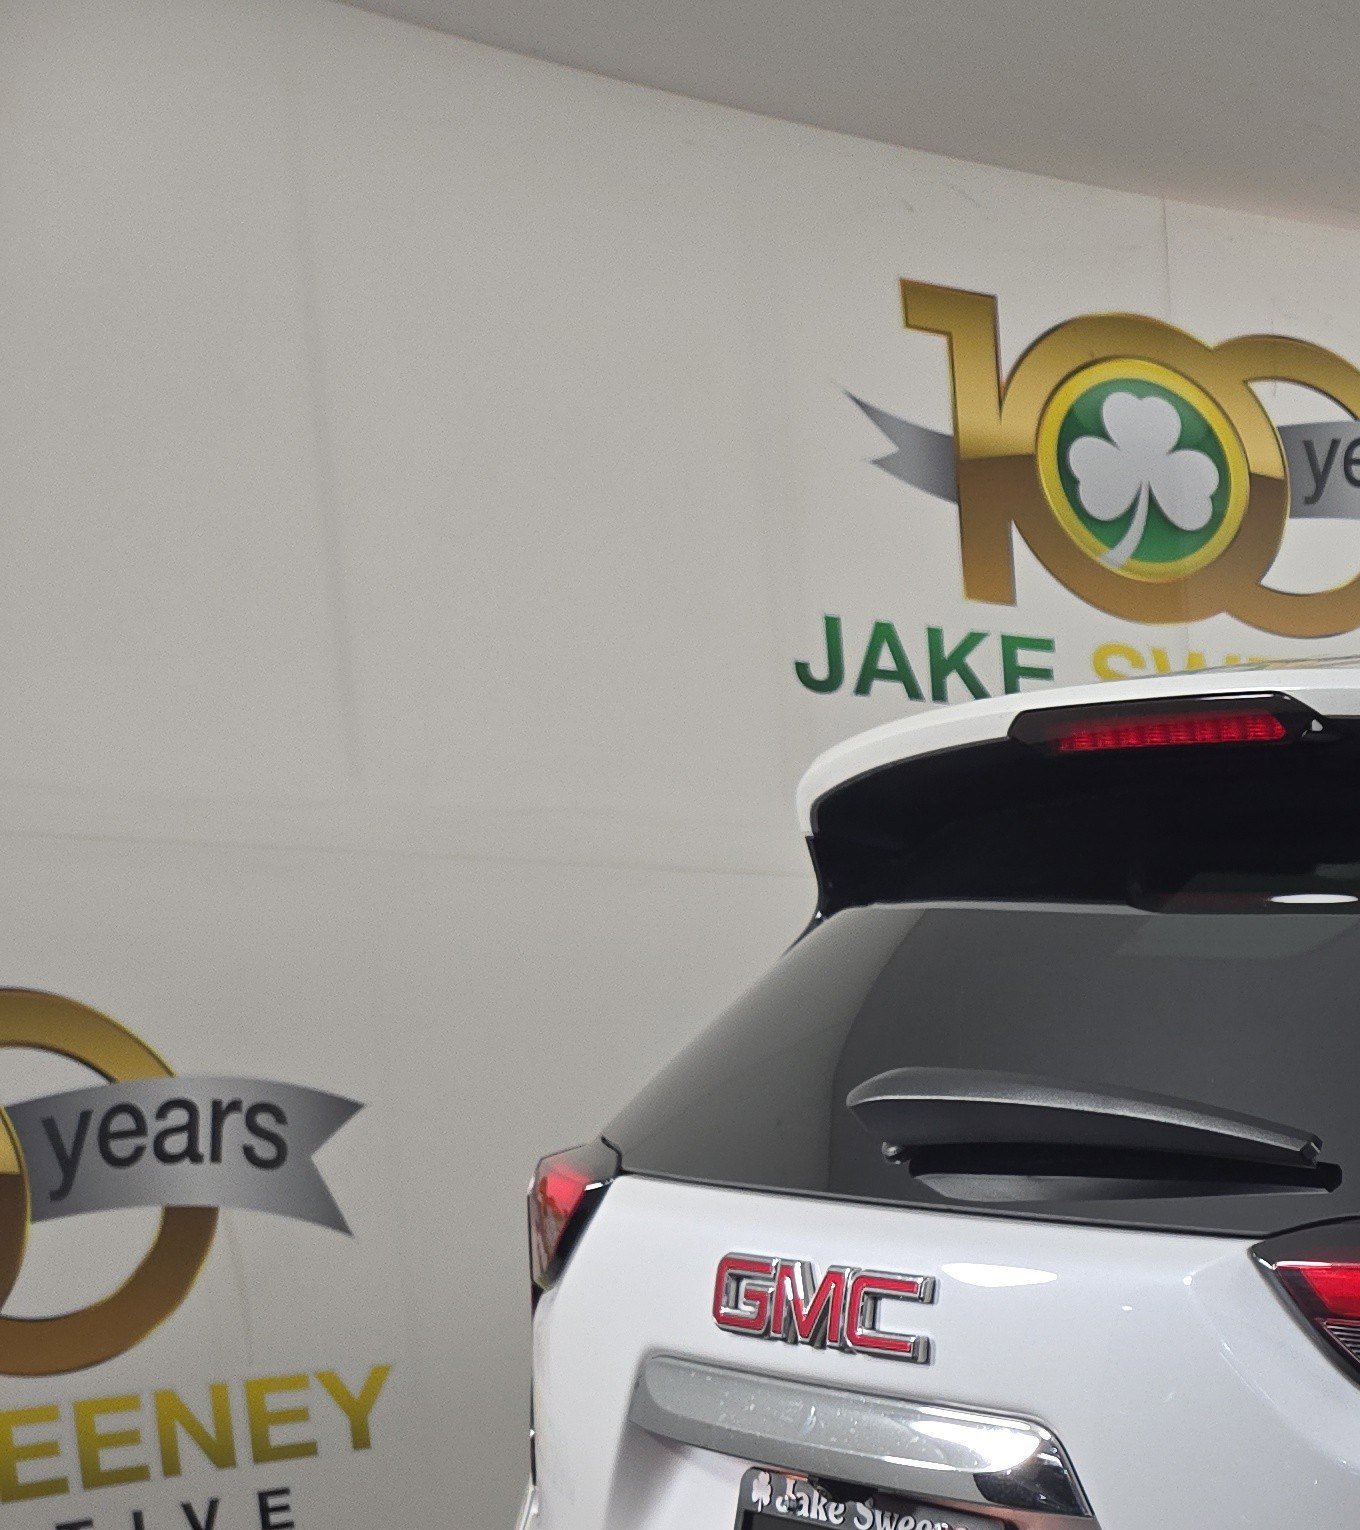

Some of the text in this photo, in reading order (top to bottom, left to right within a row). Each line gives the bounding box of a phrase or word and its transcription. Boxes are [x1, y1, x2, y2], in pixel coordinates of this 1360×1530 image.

[794, 614, 1056, 704] JAKE
[42, 1098, 289, 1200] years
[712, 1251, 937, 1364] GMC
[776, 1477, 846, 1525] Jake
